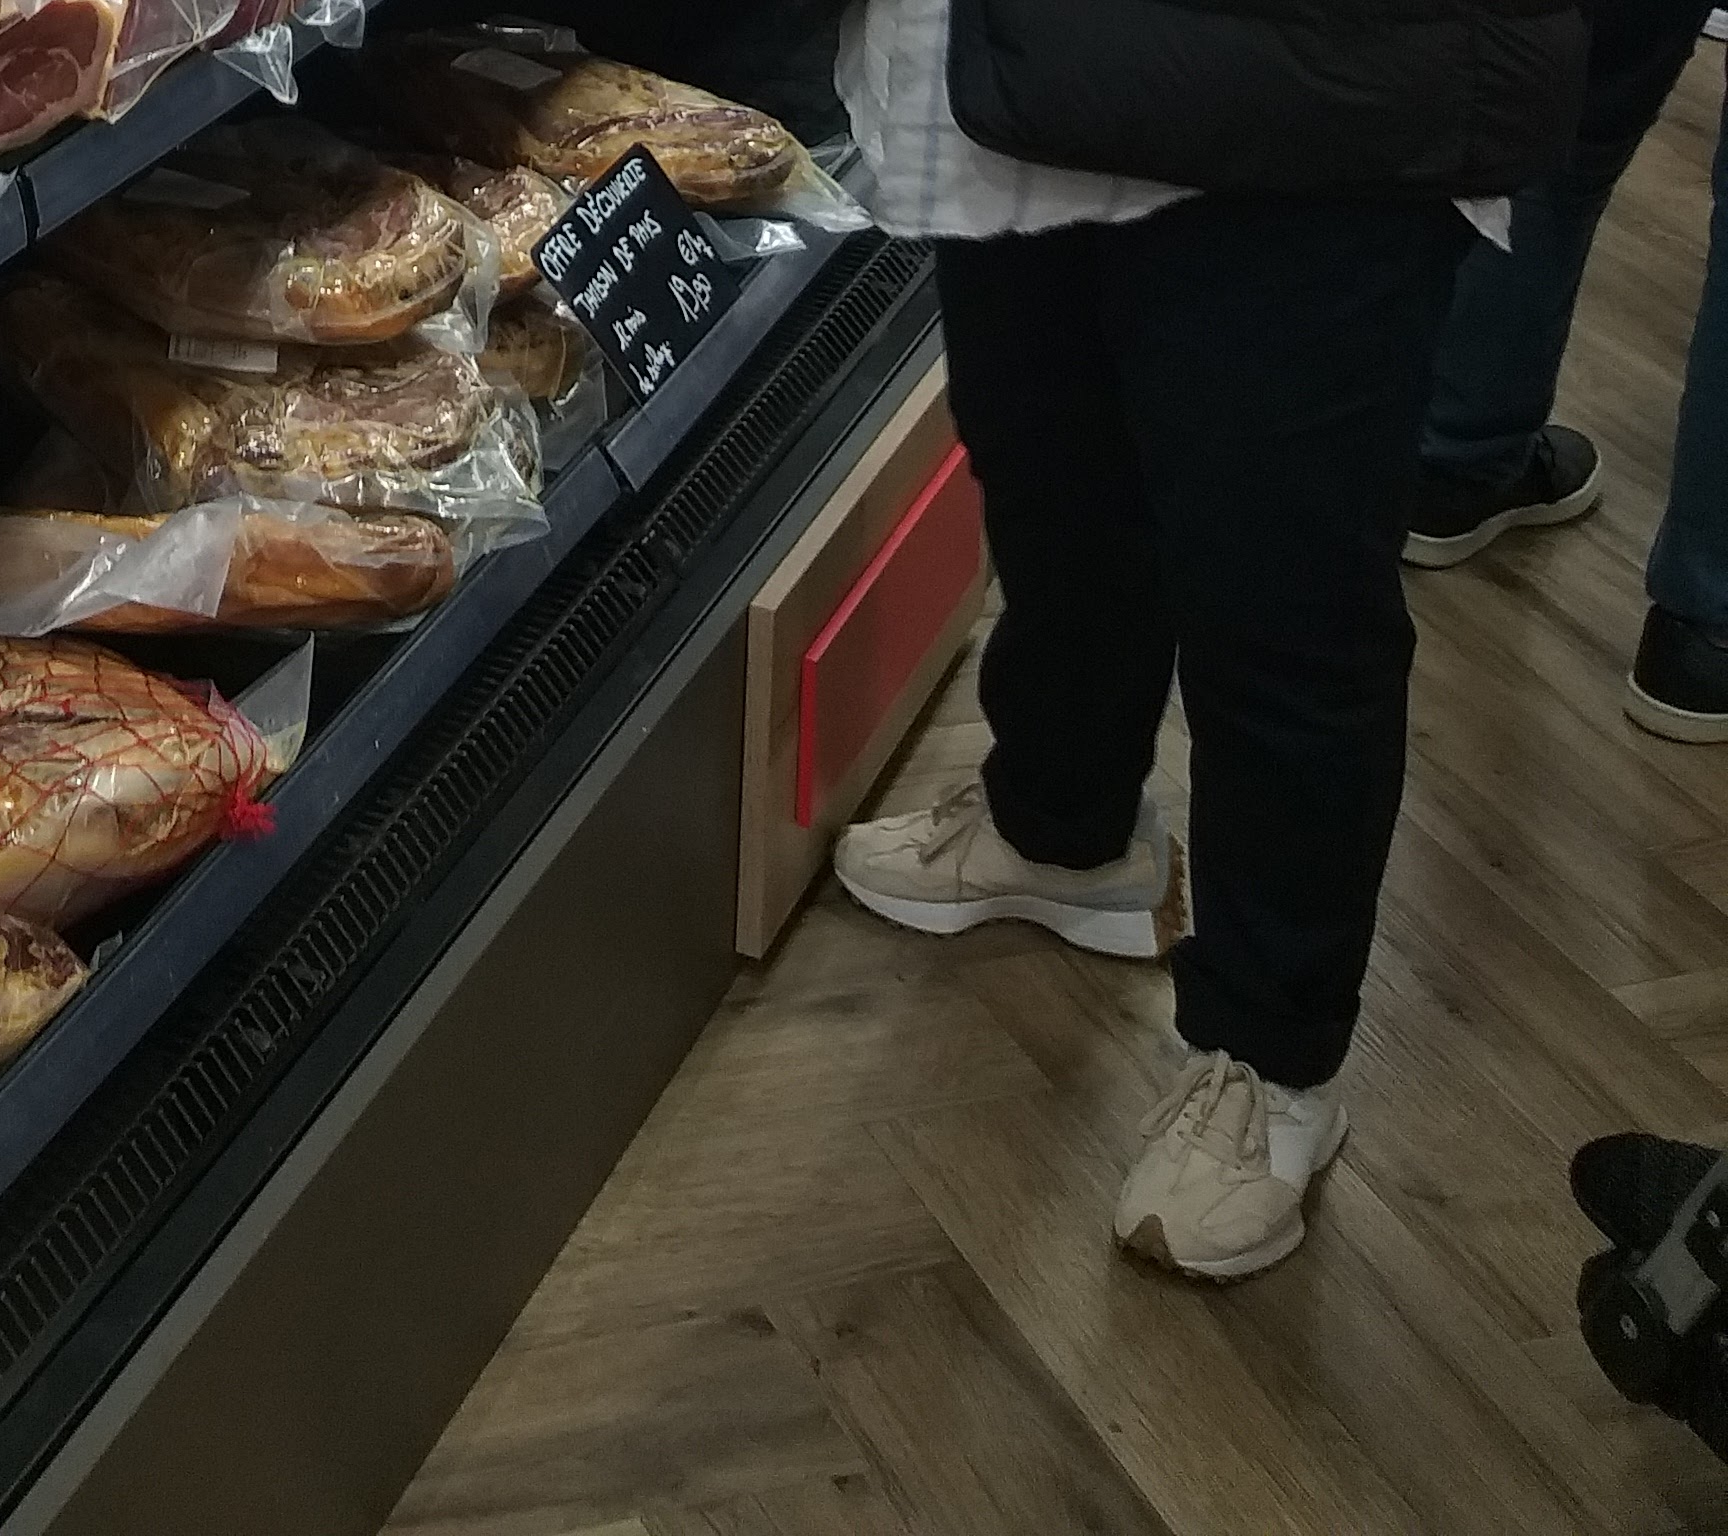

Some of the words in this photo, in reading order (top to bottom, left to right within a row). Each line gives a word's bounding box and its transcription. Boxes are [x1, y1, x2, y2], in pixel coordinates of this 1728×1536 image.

[540, 222, 583, 282] OFFRE
[573, 259, 619, 319] JAMBON
[613, 236, 635, 273] DE
[629, 209, 662, 251] PAYS
